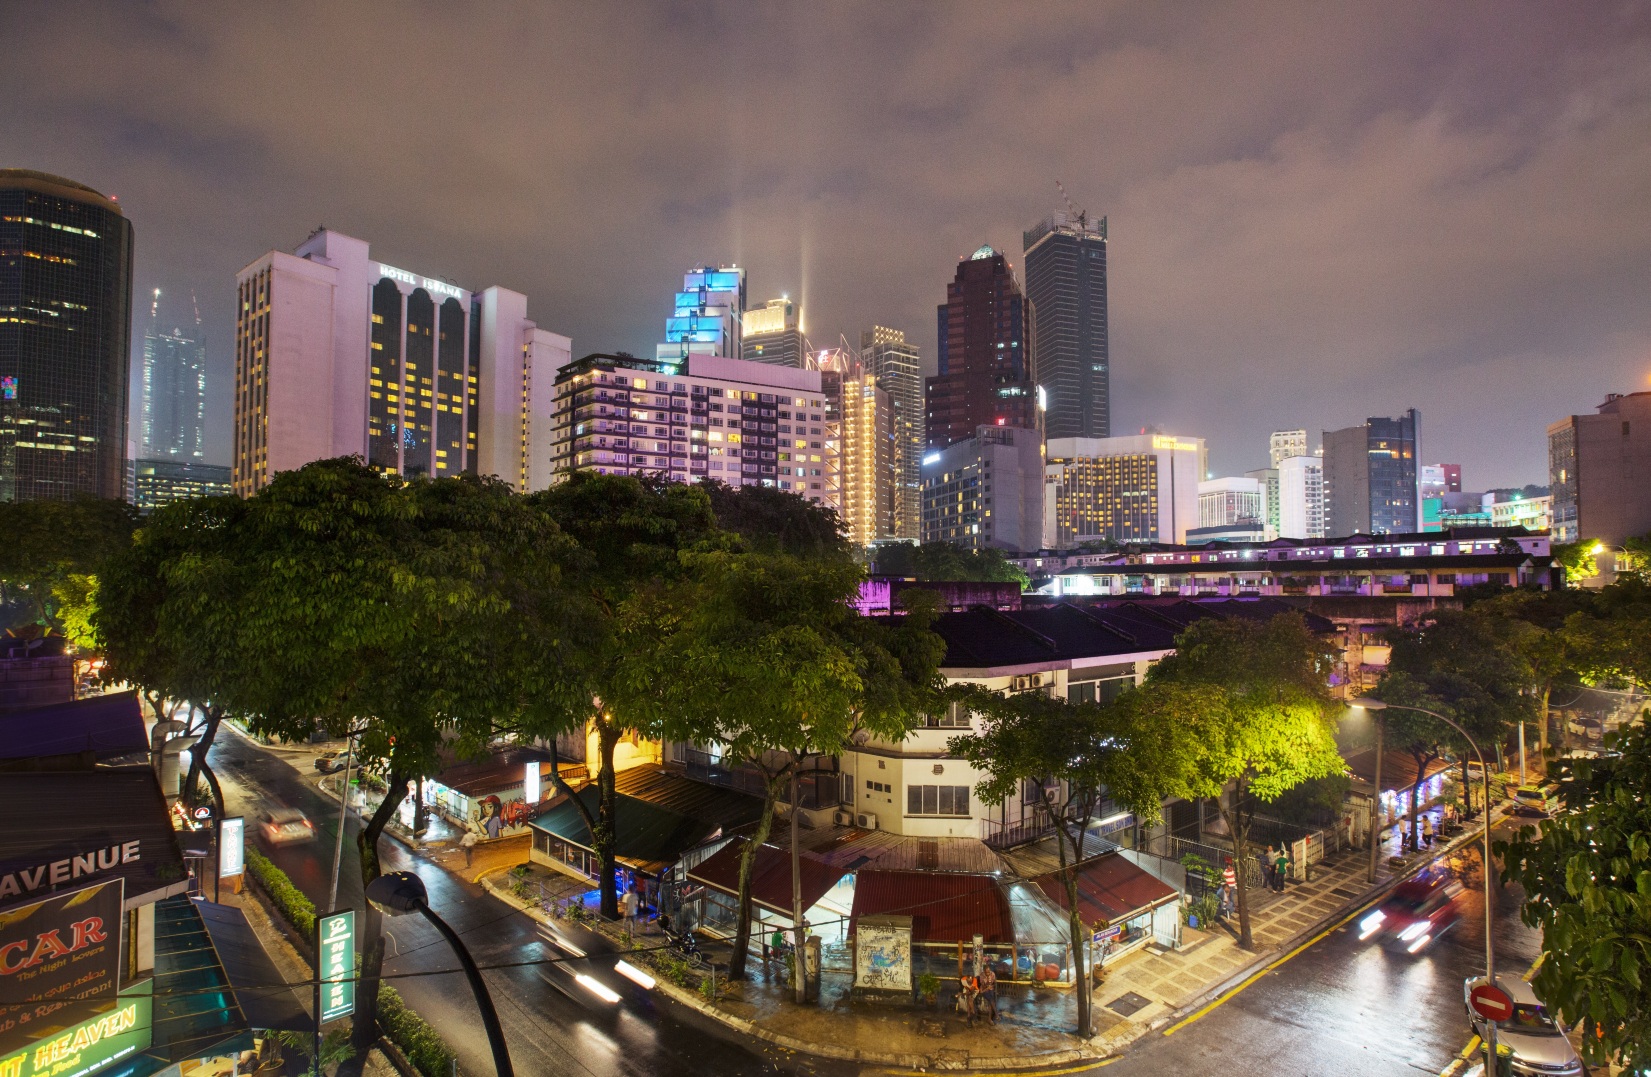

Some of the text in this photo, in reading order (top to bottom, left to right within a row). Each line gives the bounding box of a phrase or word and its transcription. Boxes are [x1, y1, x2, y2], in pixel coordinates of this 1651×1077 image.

[380, 265, 462, 298] HOTEL ISTANA
[0, 840, 140, 900] AVENUE
[17, 971, 37, 981] The
[39, 959, 67, 975] Night
[330, 941, 345, 1008] HEAVEN
[19, 1013, 31, 1023] &
[33, 1004, 136, 1071] HEAVEN
[51, 1053, 81, 1076] Food
